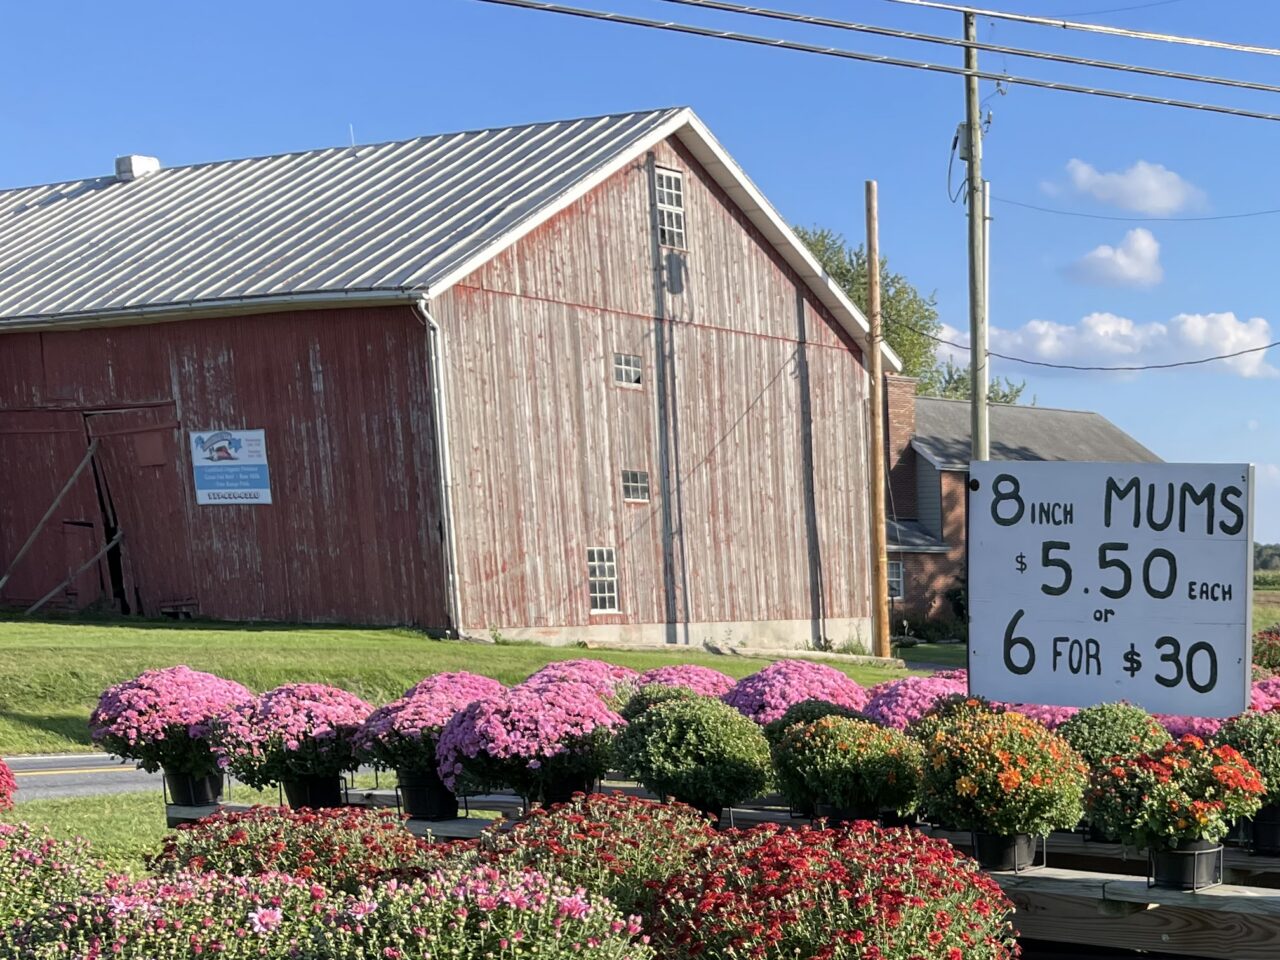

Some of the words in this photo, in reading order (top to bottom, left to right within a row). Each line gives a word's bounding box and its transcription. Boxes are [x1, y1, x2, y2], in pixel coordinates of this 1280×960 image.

[990, 473, 1025, 527] 8
[1030, 502, 1074, 526] INCH
[1104, 476, 1244, 536] MUMS
[1188, 581, 1233, 602] EACH
[1093, 608, 1115, 623] or
[1003, 608, 1036, 676] 6
[1052, 635, 1102, 676] FOR
